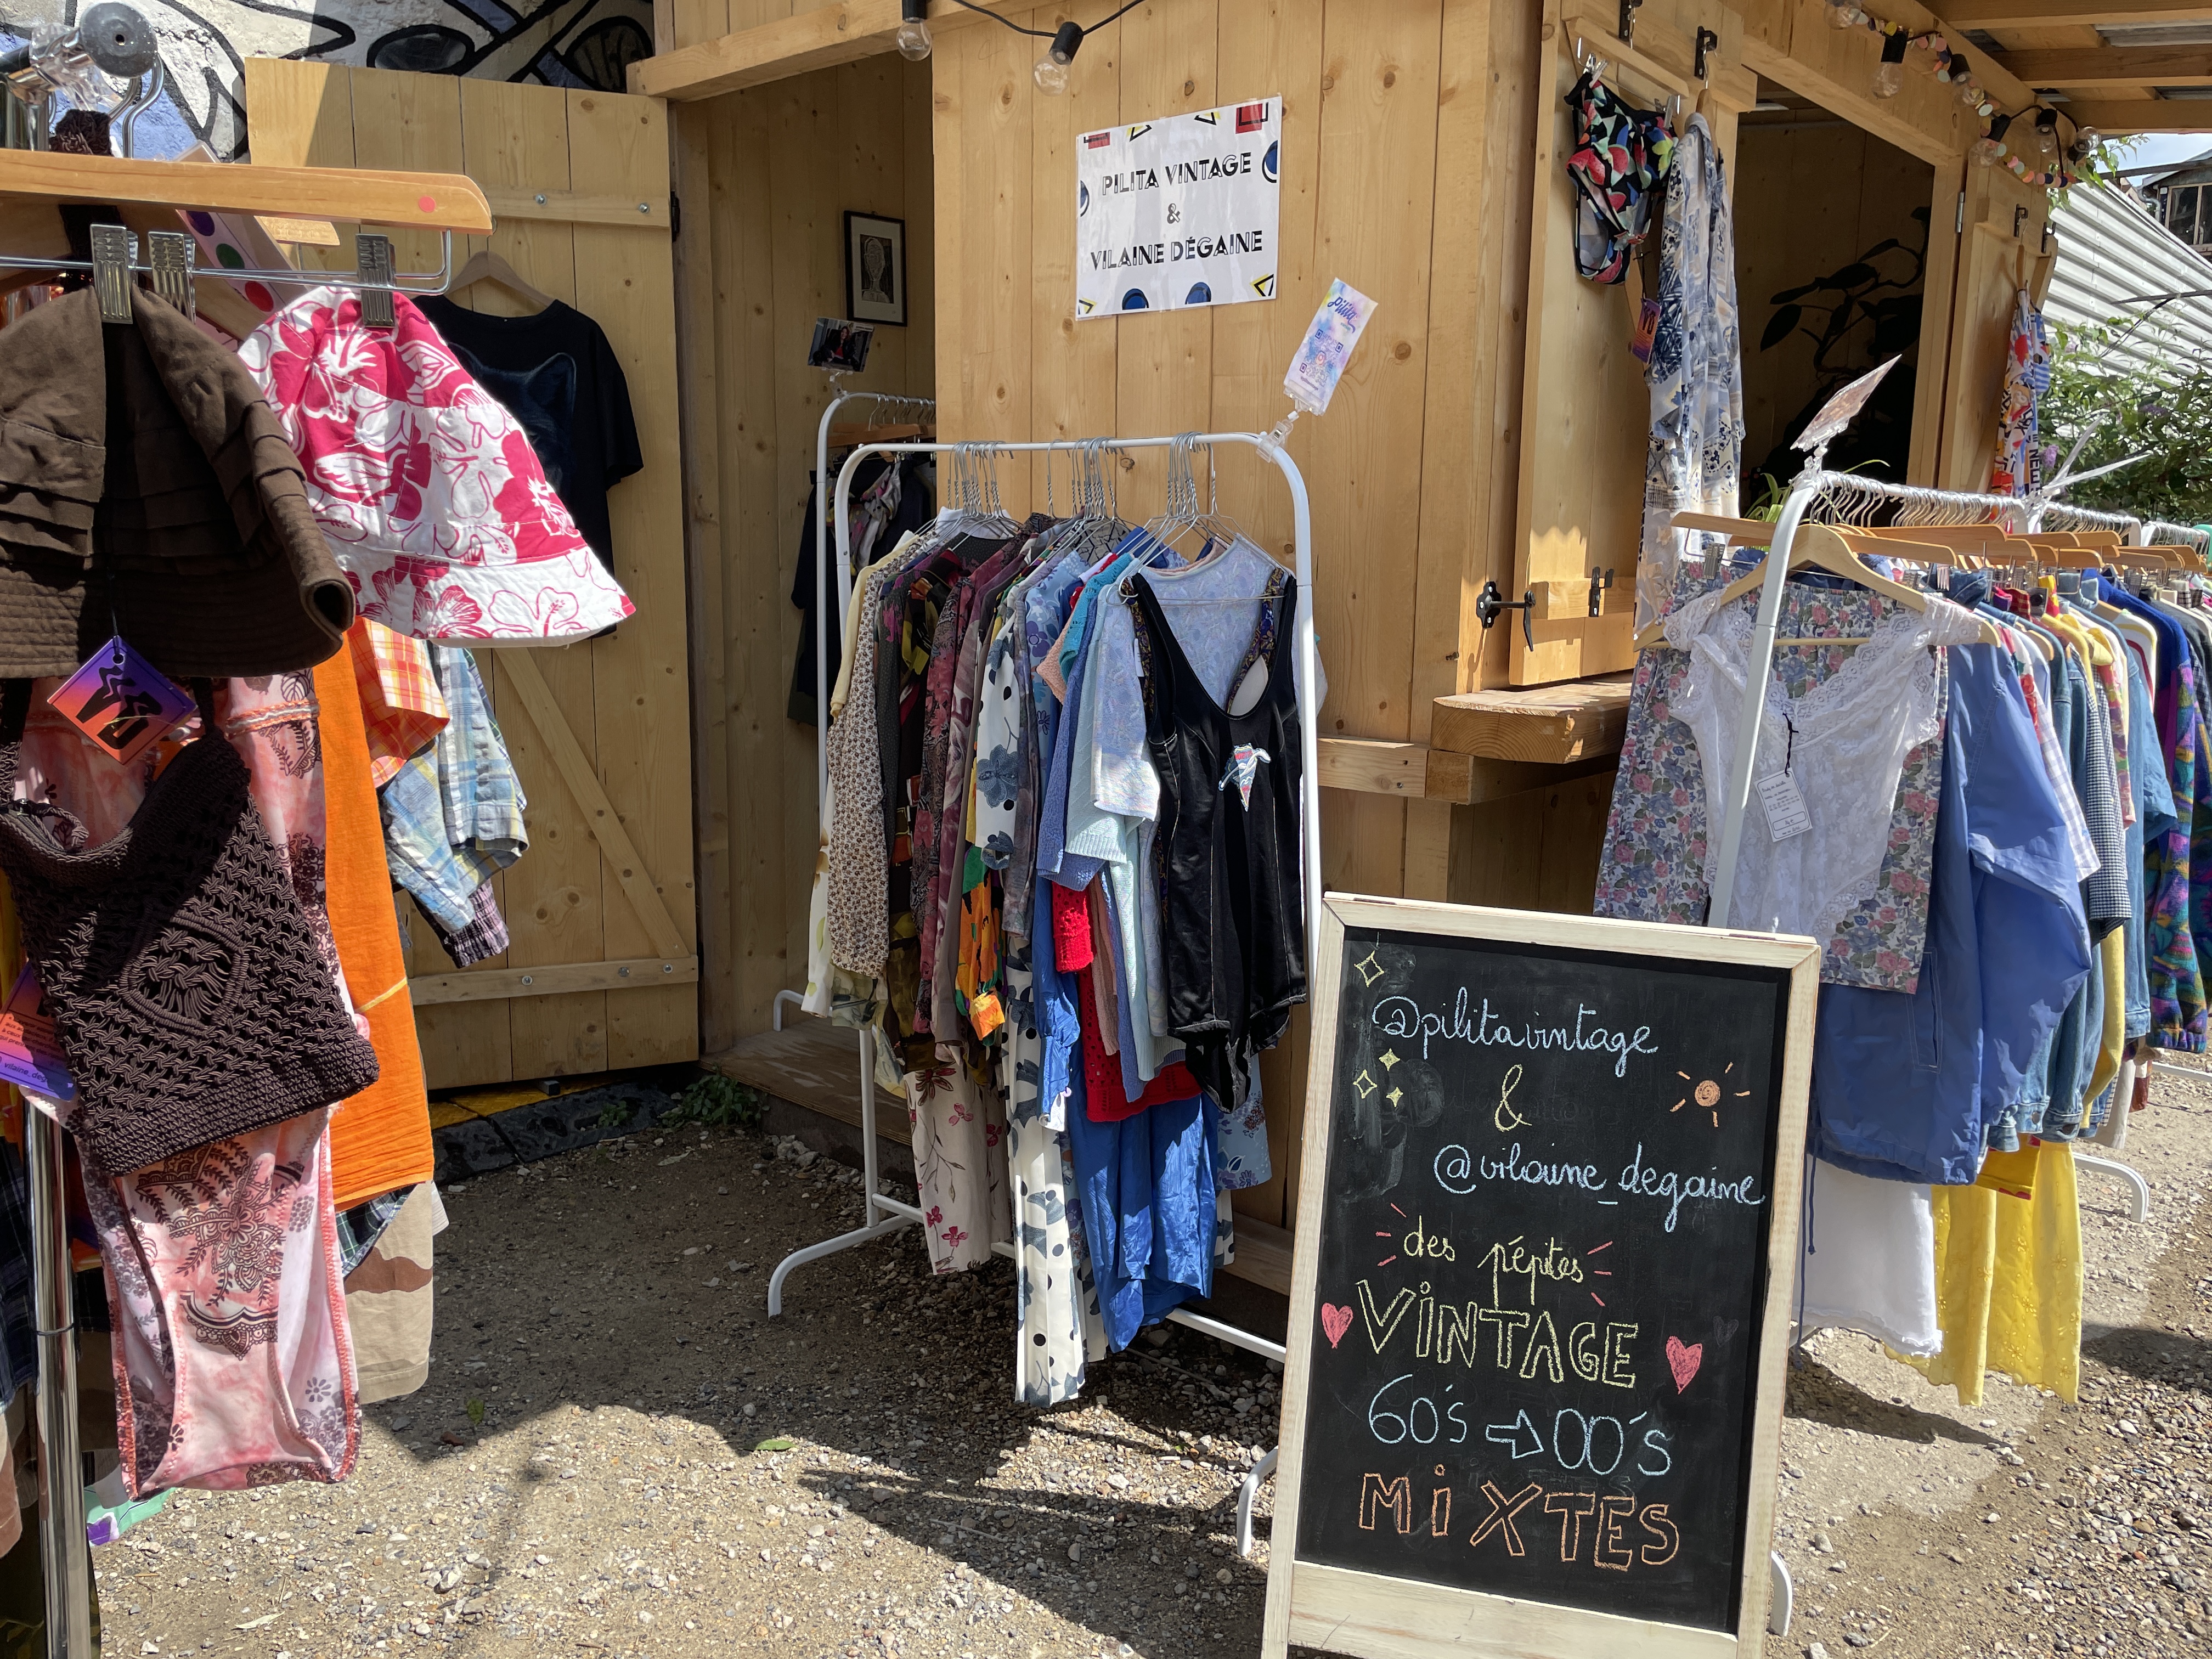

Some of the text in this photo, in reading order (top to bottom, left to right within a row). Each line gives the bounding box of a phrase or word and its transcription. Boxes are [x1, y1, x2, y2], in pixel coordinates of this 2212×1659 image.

[1102, 152, 1251, 196] PILITA VINTAGE
[1166, 203, 1181, 224] &
[1091, 230, 1263, 271] VILAINE DÉGAINE
[1371, 986, 1659, 1078] @pilitavintage
[1494, 1064, 1532, 1132] &
[1403, 1215, 1584, 1310] des pépites
